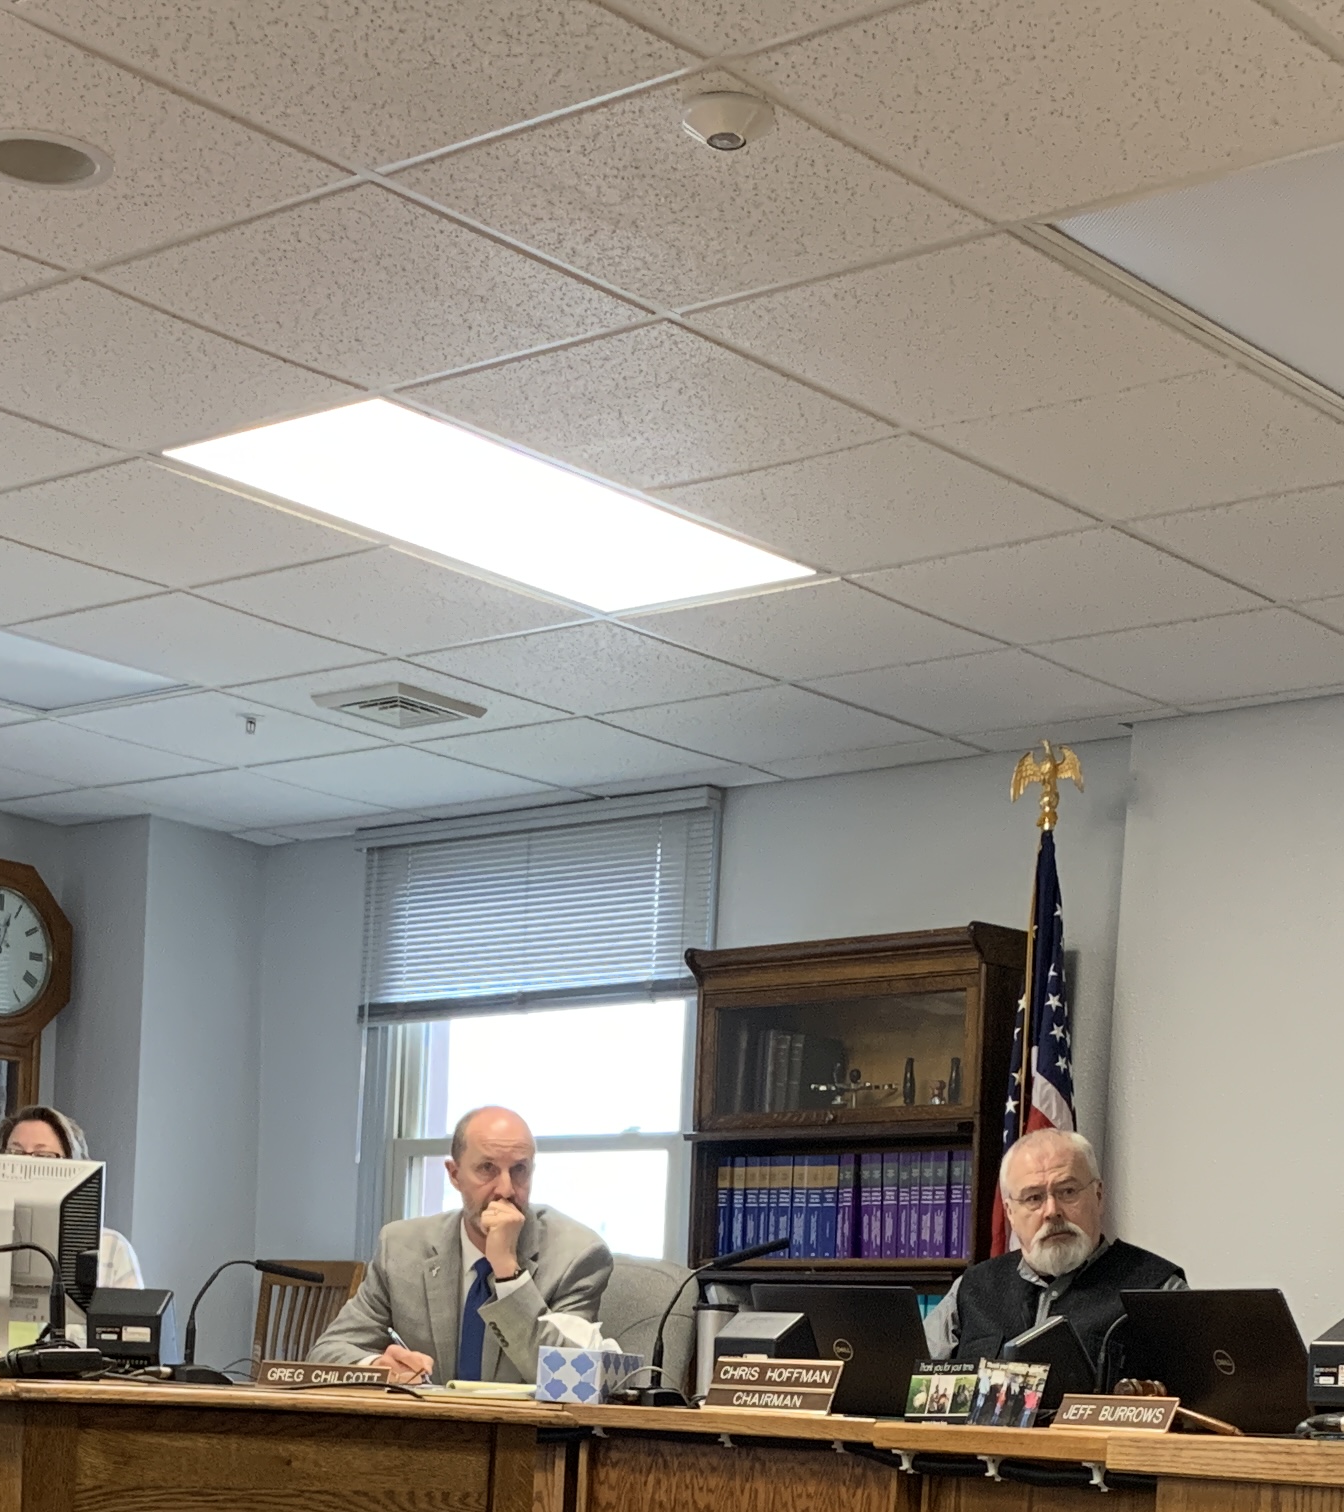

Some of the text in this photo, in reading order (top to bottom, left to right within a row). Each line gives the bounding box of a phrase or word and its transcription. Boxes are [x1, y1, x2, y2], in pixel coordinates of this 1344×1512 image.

[267, 1367, 382, 1384] GREG CHILCOTT
[719, 1365, 833, 1384] CHRIS HOFFMAN
[732, 1391, 803, 1408] CHAIRMAN
[1062, 1404, 1165, 1424] JEFF BURROWS
